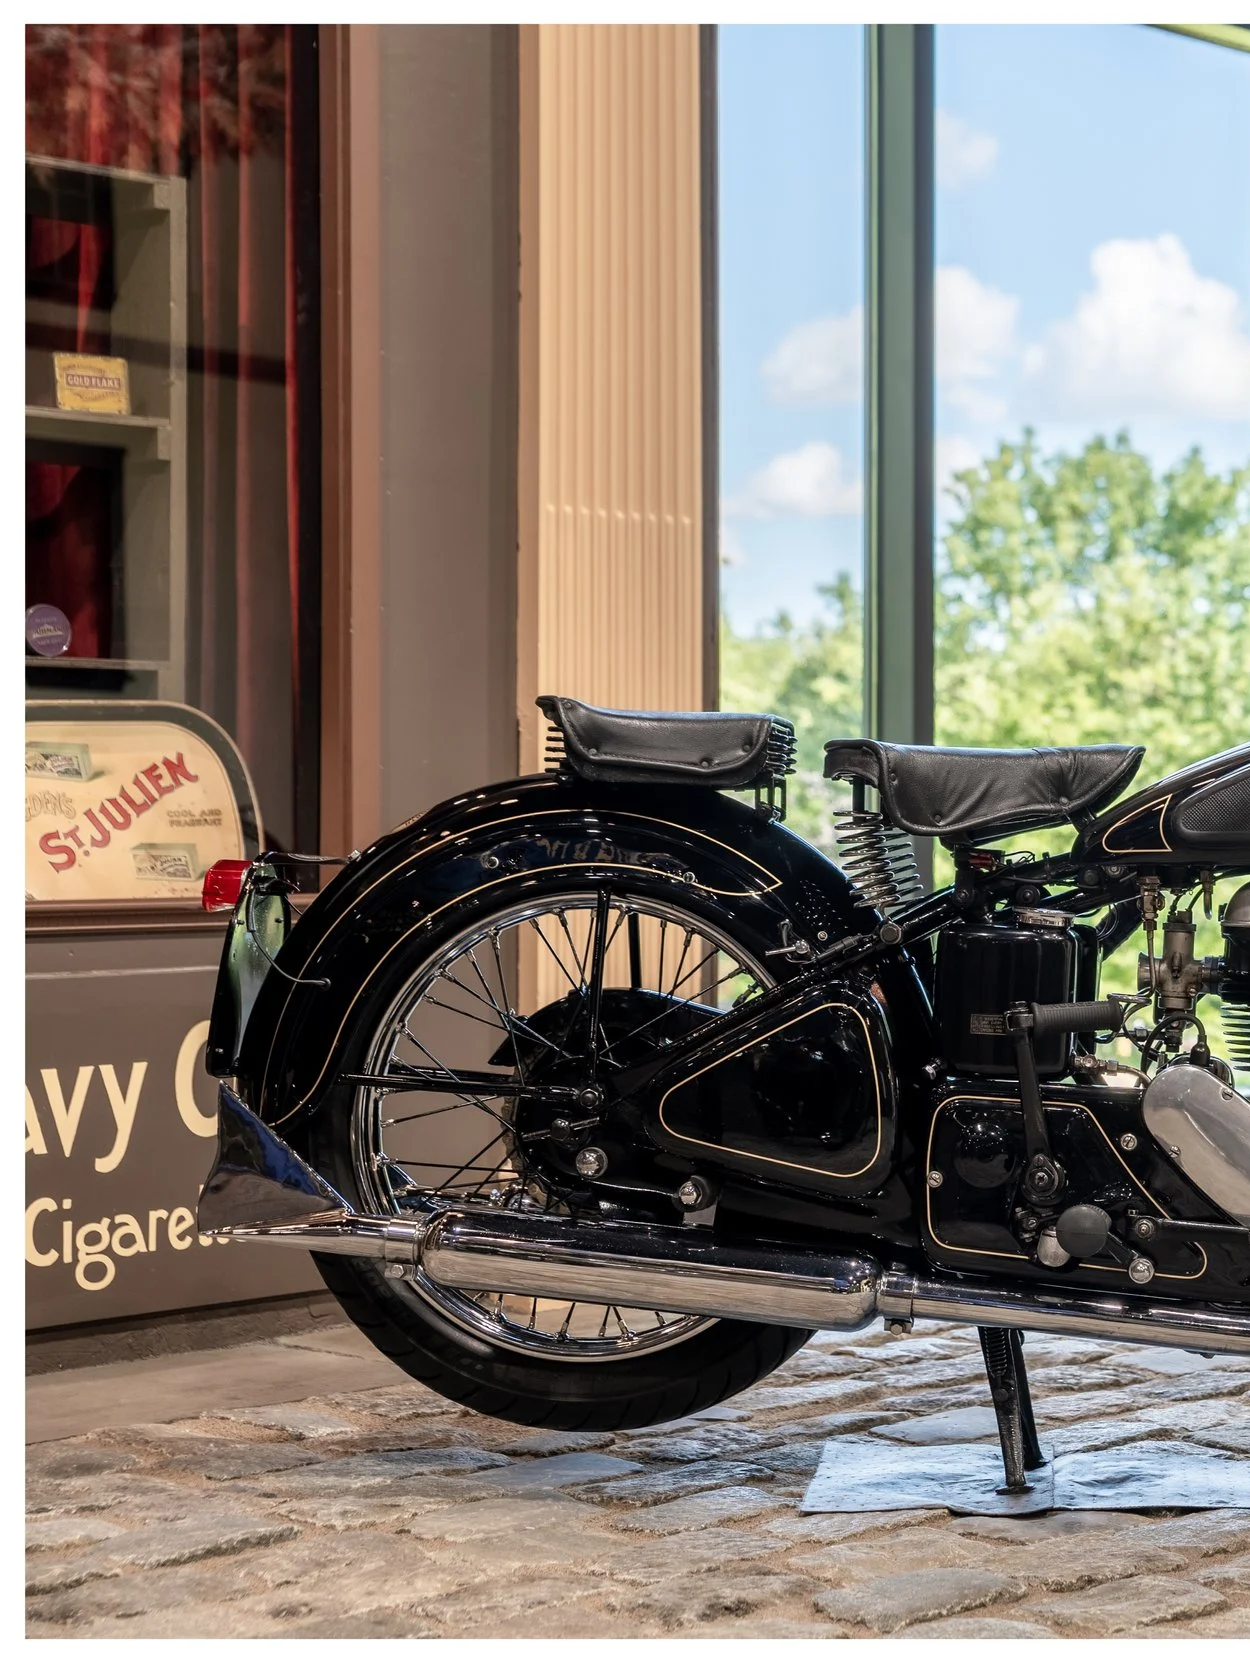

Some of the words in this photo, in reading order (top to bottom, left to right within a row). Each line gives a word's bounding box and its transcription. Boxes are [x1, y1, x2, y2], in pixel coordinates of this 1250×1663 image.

[25, 789, 77, 823] DEN'S
[83, 751, 199, 849] JULIEN
[167, 809, 196, 818] COOL
[200, 808, 222, 817] AND
[169, 818, 222, 828] FRAGRANT
